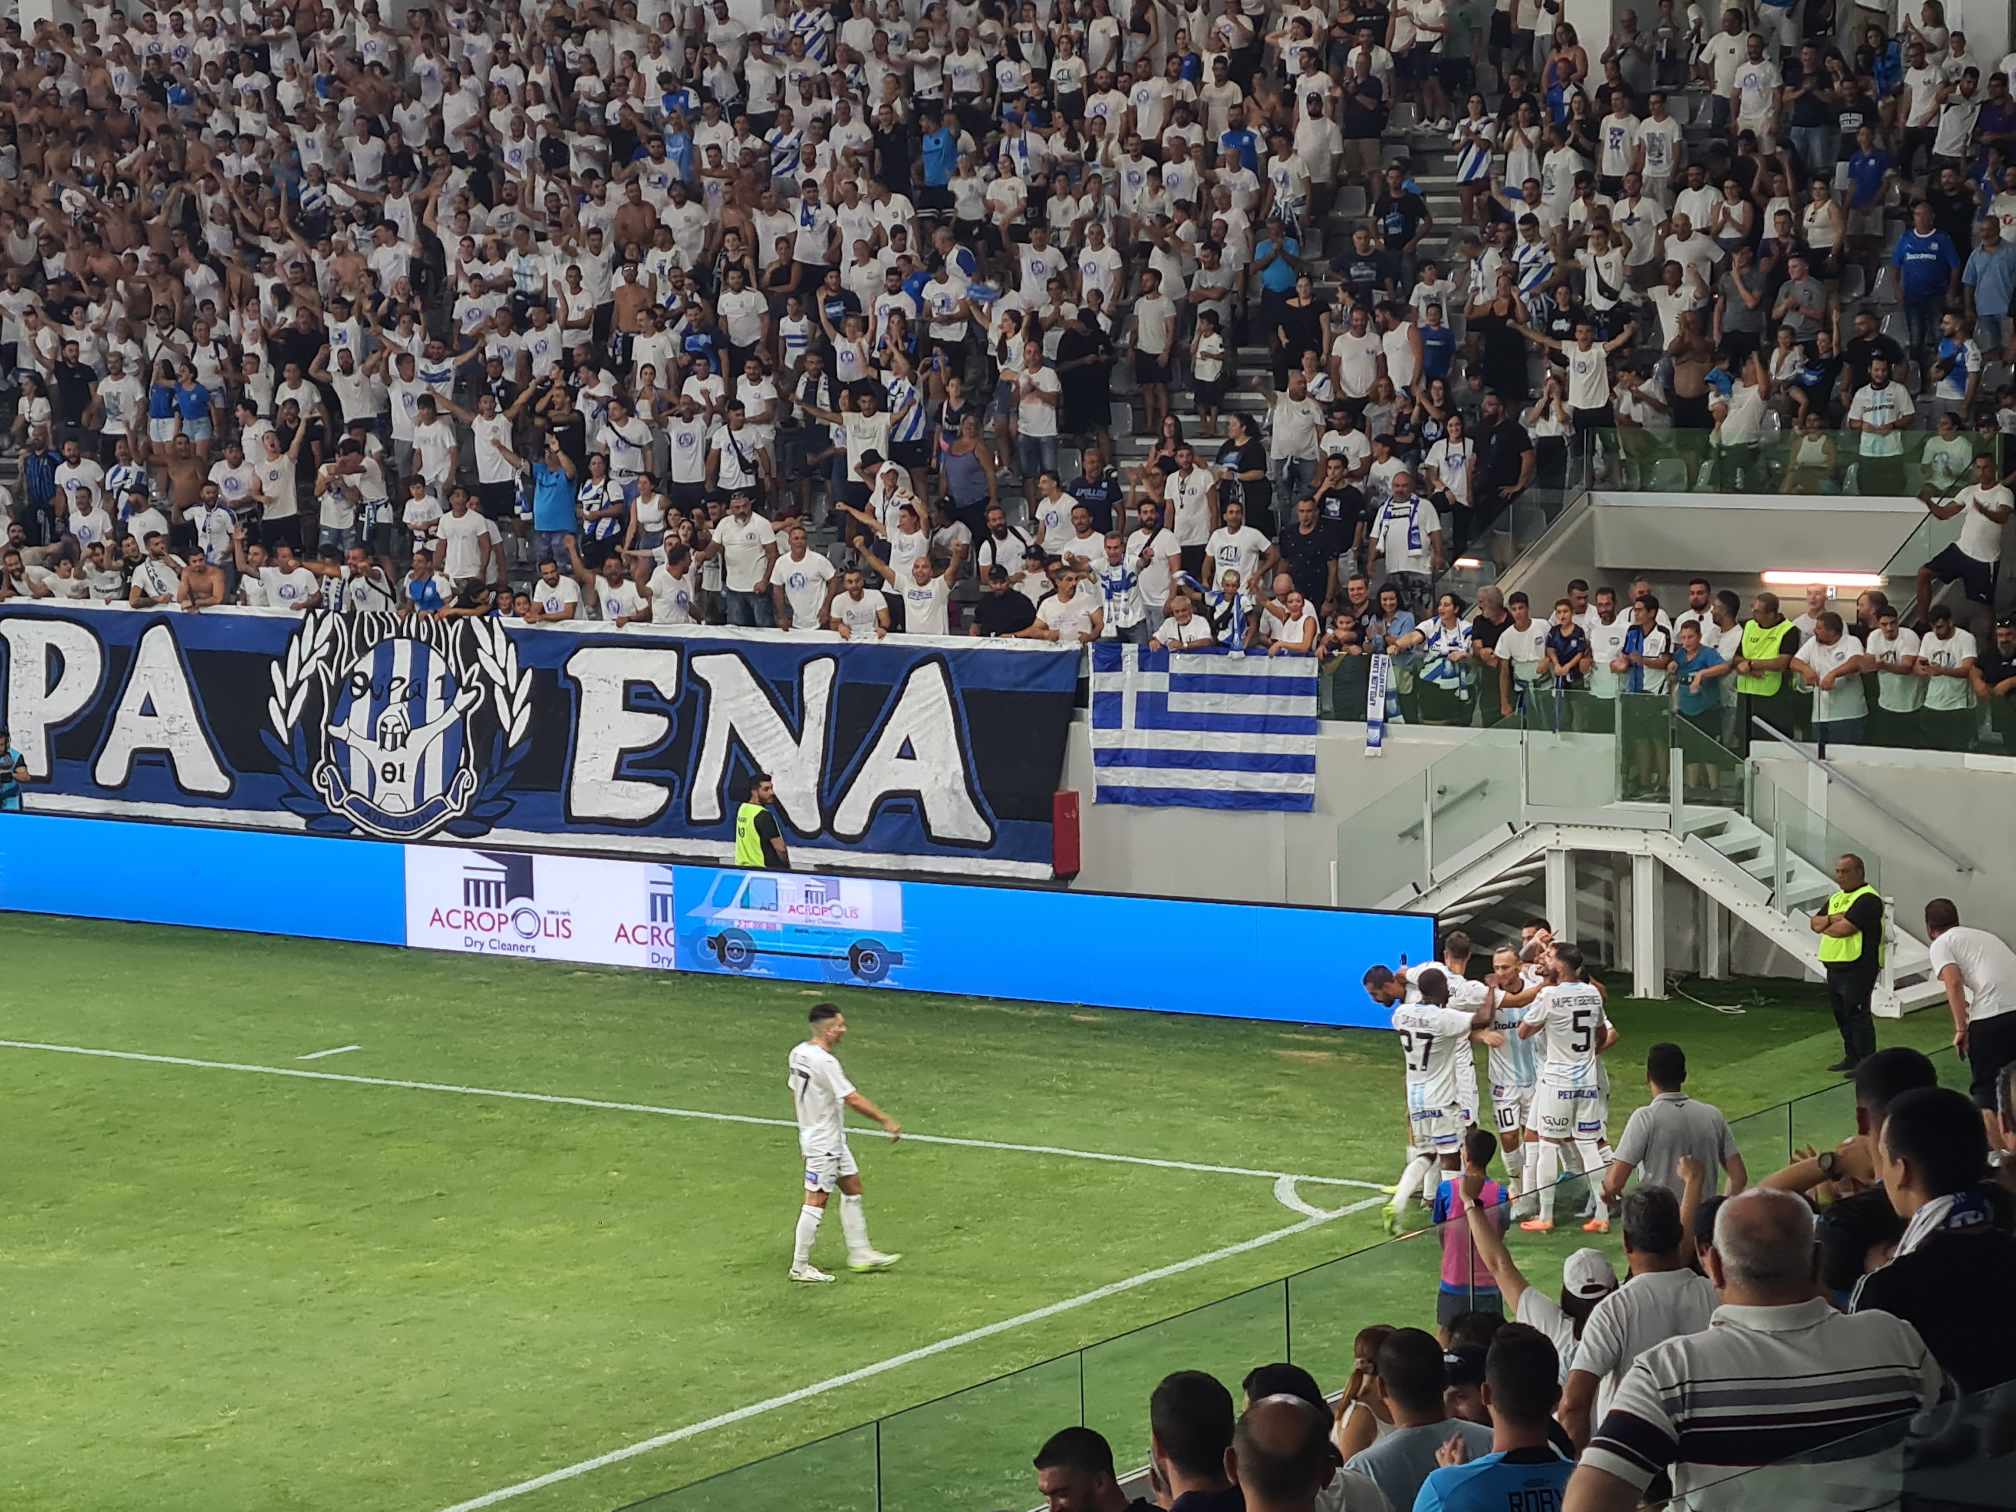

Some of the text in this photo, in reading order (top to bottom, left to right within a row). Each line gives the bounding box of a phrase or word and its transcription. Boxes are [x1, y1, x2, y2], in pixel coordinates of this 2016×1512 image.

[429, 907, 572, 940] ACROPOLIS
[464, 935, 536, 954] Dry Cleaners
[651, 952, 672, 967] Dry
[1571, 1010, 1591, 1053] 5
[1399, 1028, 1434, 1071] 27
[790, 1067, 811, 1104] 7
[1497, 1108, 1514, 1128] 10
